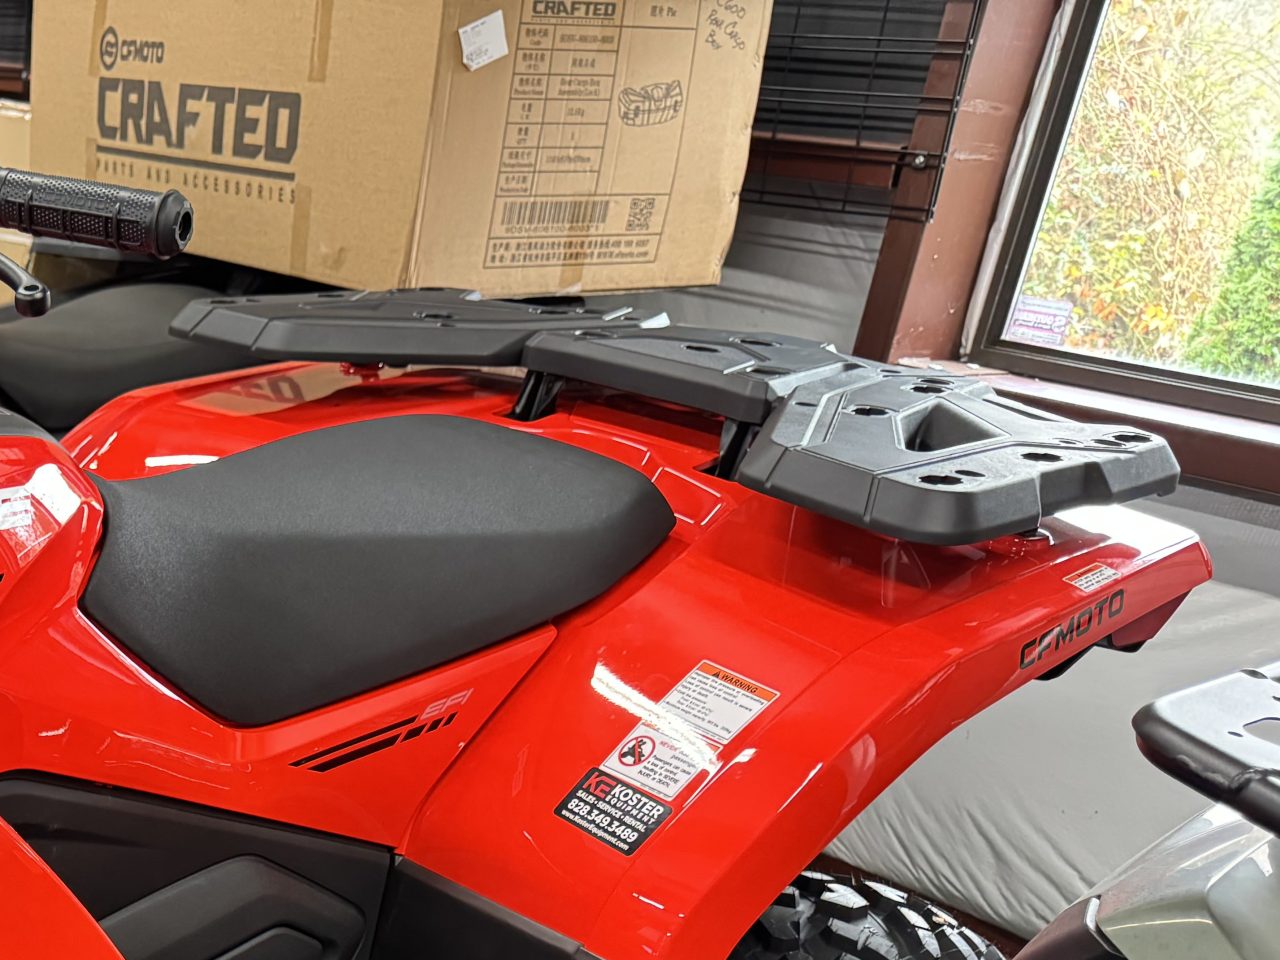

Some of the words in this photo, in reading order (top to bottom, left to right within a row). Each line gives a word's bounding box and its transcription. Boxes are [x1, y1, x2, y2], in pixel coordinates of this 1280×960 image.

[532, 0, 616, 16] CRAFTED
[120, 39, 165, 64] CFMOTO
[98, 77, 301, 164] CRAFTED
[96, 157, 134, 178] PARTS
[147, 166, 170, 185] AND
[183, 173, 296, 204] ACCESSORIES
[1020, 588, 1124, 669] CFMOTO
[721, 674, 758, 694] WARNING
[420, 688, 474, 720] EFI
[567, 798, 639, 843] 828.349.3489
[576, 790, 596, 804] SALES
[596, 801, 623, 819] SERVICE
[622, 816, 648, 833] RENTAL
[605, 795, 656, 825] EQUIPMENT
[610, 784, 664, 819] KOSTER
[561, 809, 629, 851] www.KosterEquipment.com
